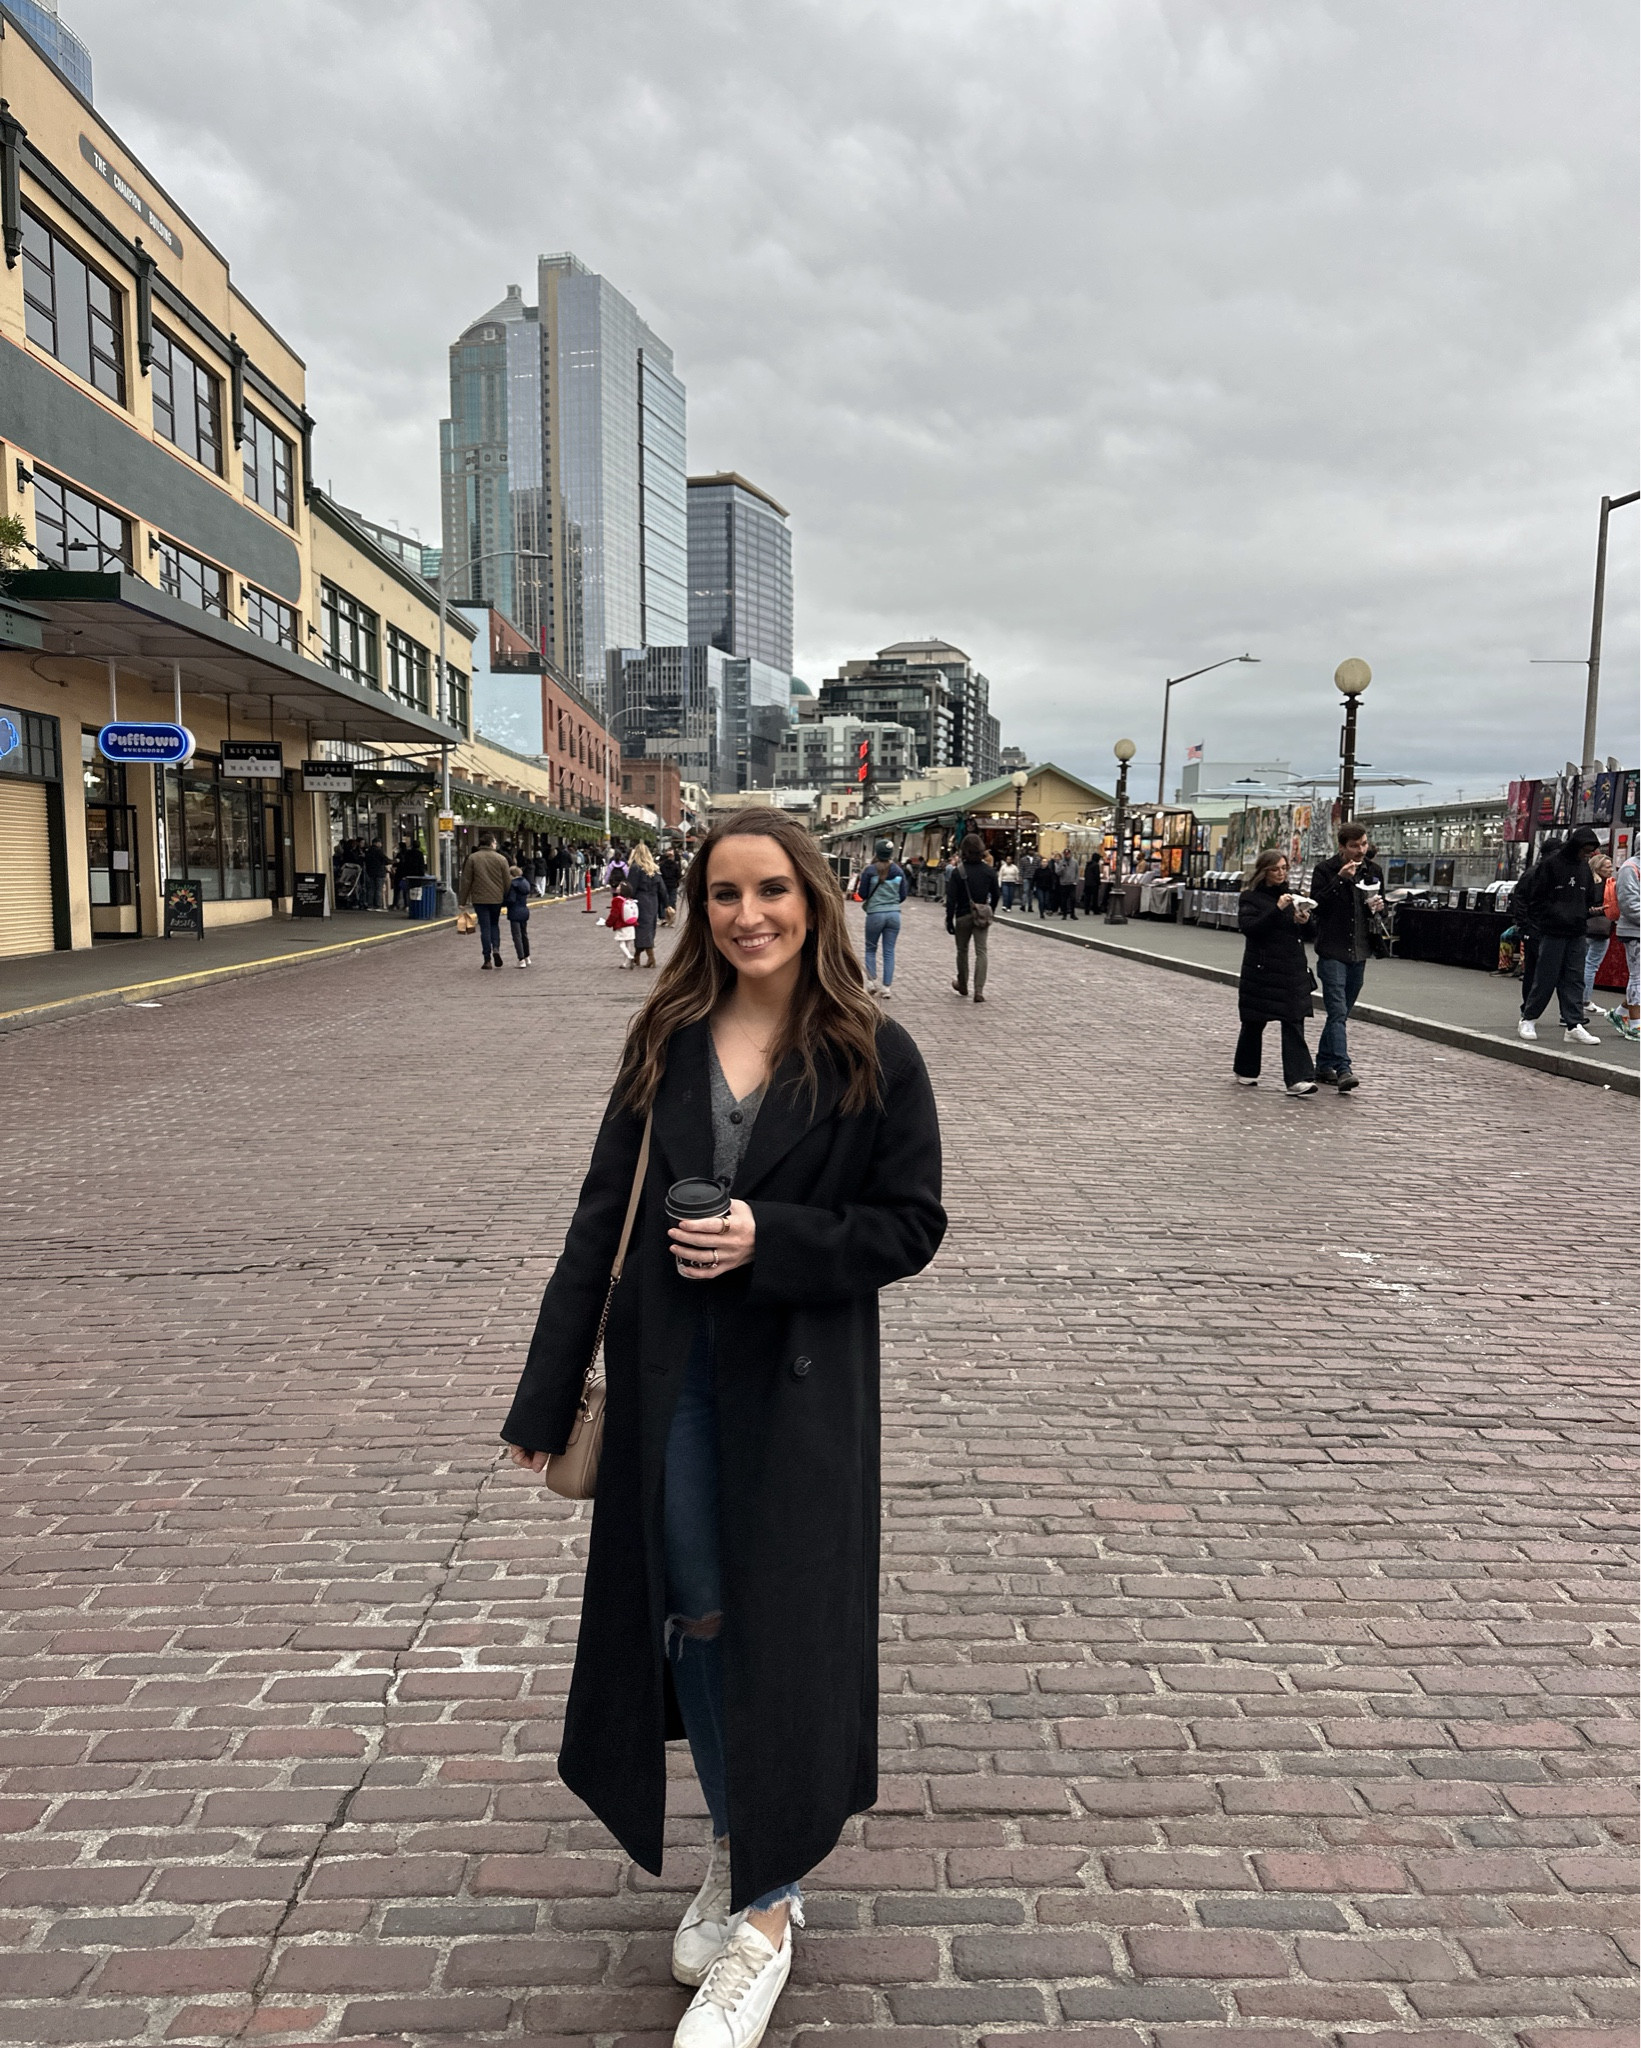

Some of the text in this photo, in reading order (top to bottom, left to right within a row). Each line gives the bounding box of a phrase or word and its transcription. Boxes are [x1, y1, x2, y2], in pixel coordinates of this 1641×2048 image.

[93, 152, 107, 177] THE
[149, 210, 172, 246] BUILDING
[107, 732, 180, 748] Pufftown
